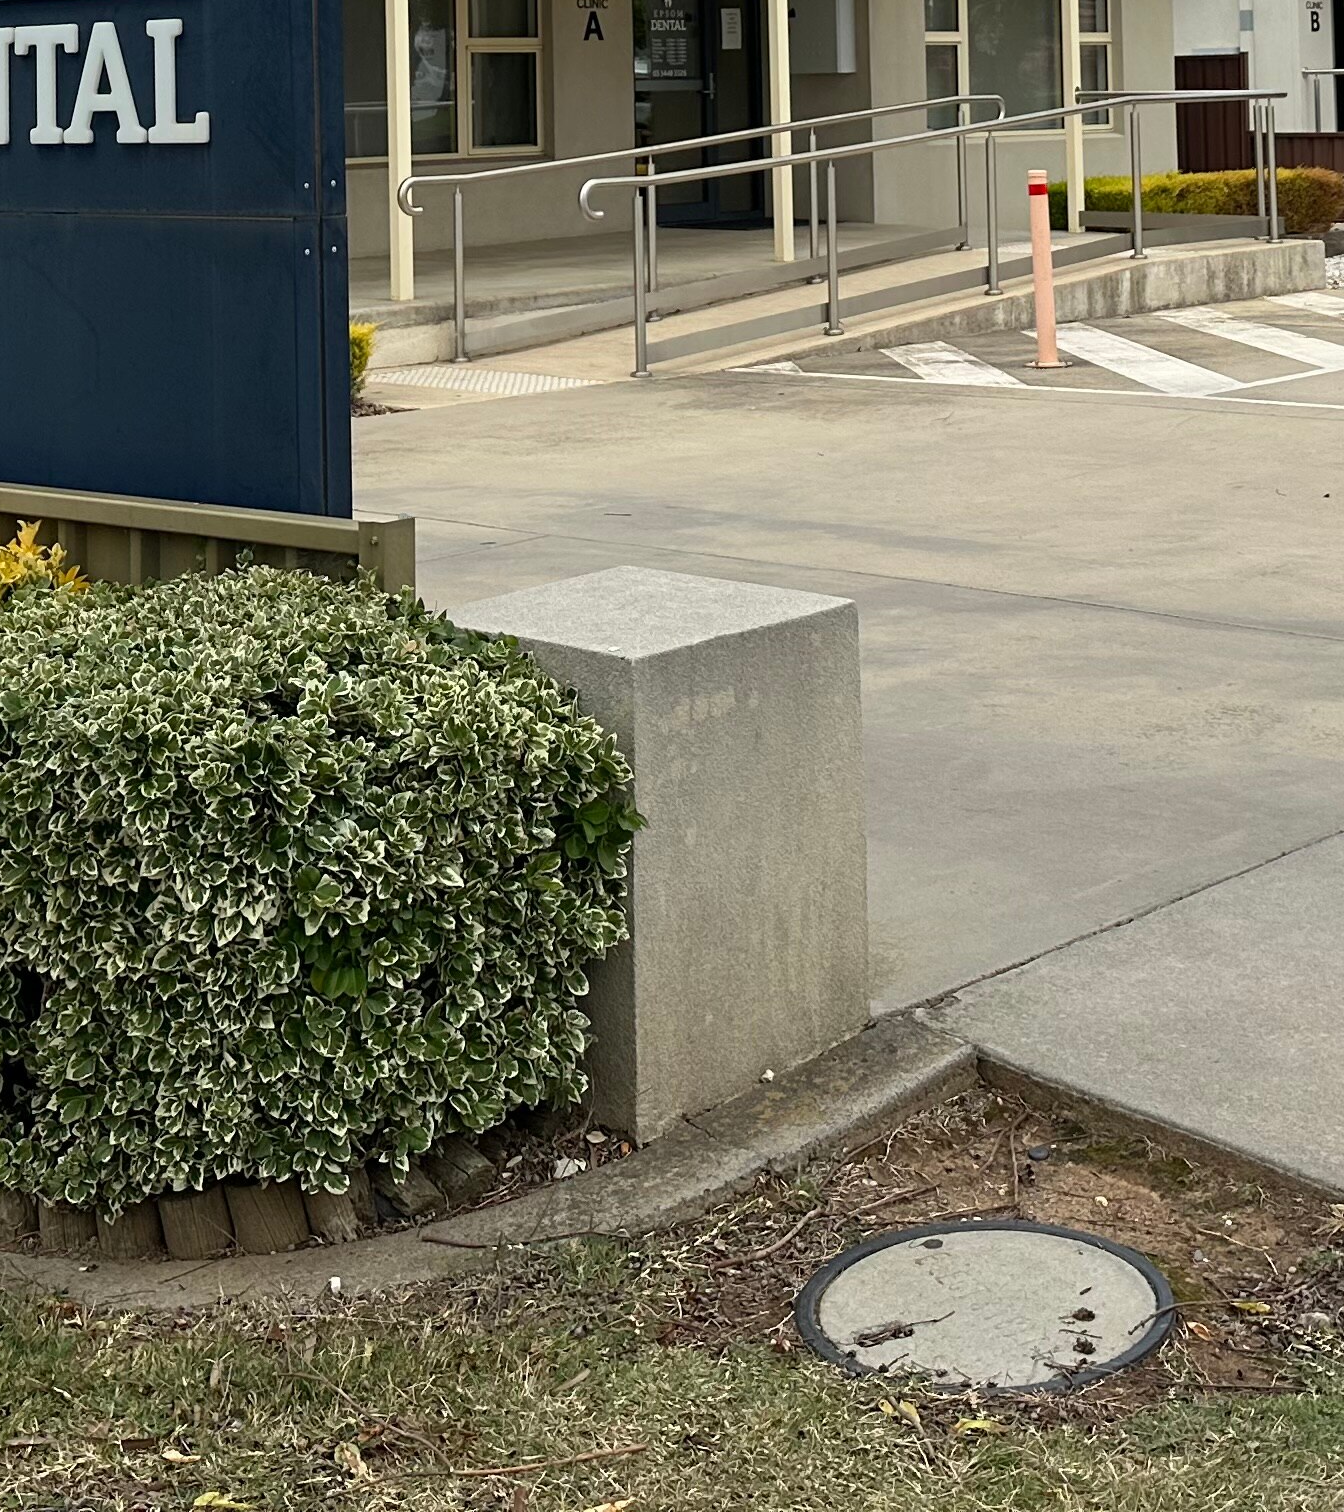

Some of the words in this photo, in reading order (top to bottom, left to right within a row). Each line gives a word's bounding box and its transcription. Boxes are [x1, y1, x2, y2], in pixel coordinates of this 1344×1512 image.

[583, 11, 604, 40] A
[650, 19, 686, 30] DENTAL
[1310, 10, 1320, 32] B
